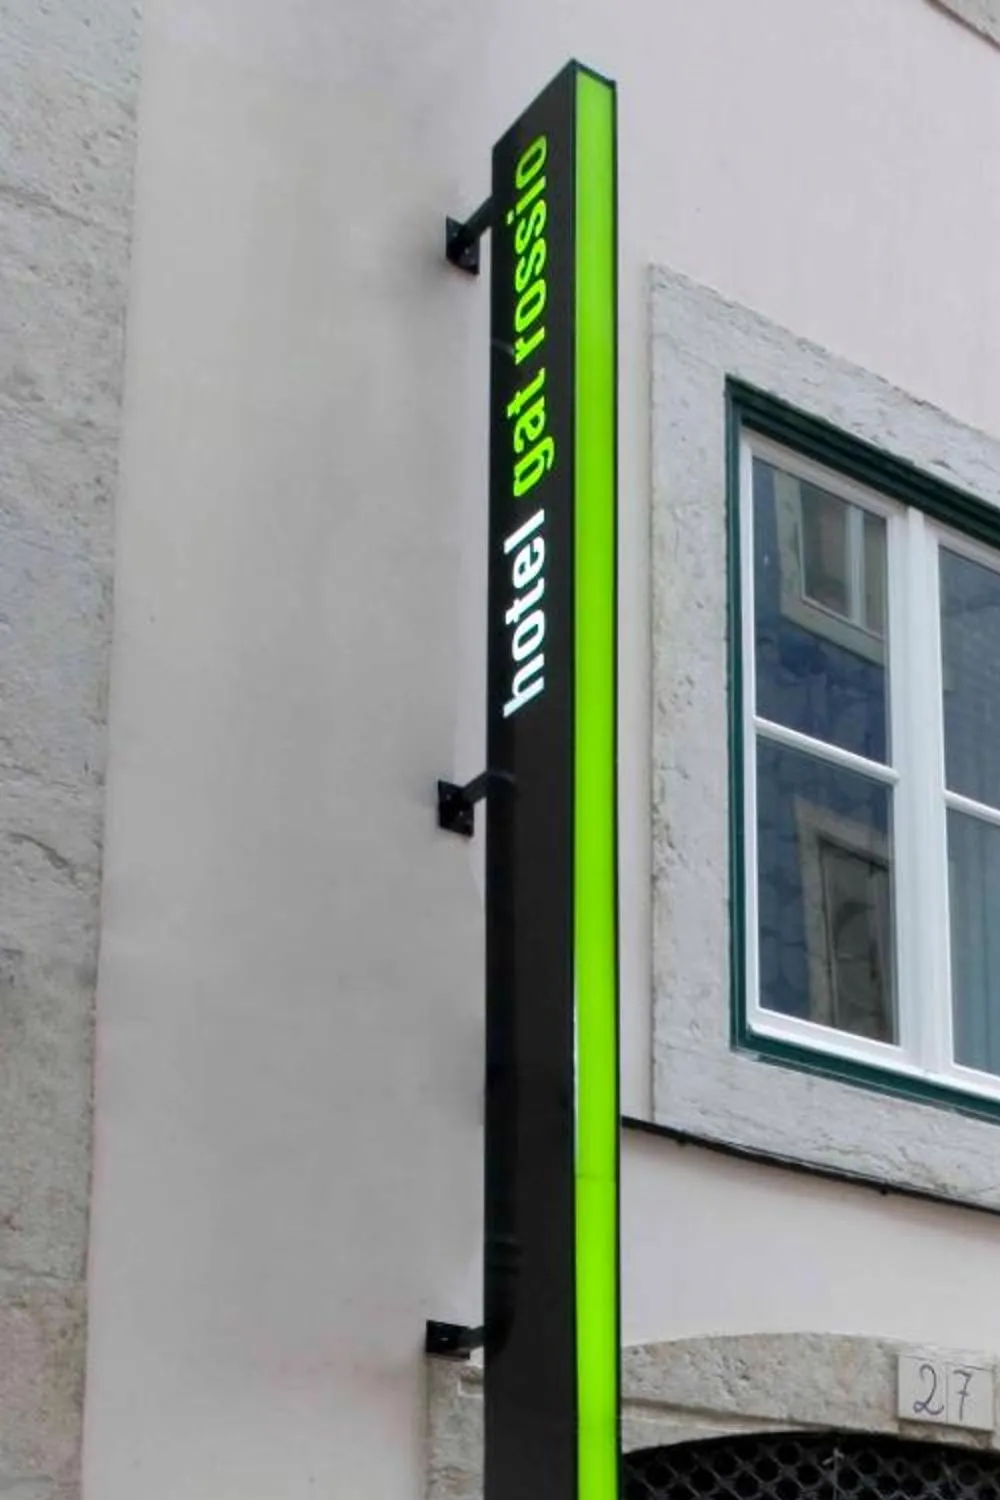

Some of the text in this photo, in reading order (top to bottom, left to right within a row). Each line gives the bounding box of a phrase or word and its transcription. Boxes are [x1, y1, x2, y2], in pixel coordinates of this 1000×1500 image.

[502, 134, 555, 719] hotel gat rossio
[912, 1363, 973, 1421] 27
